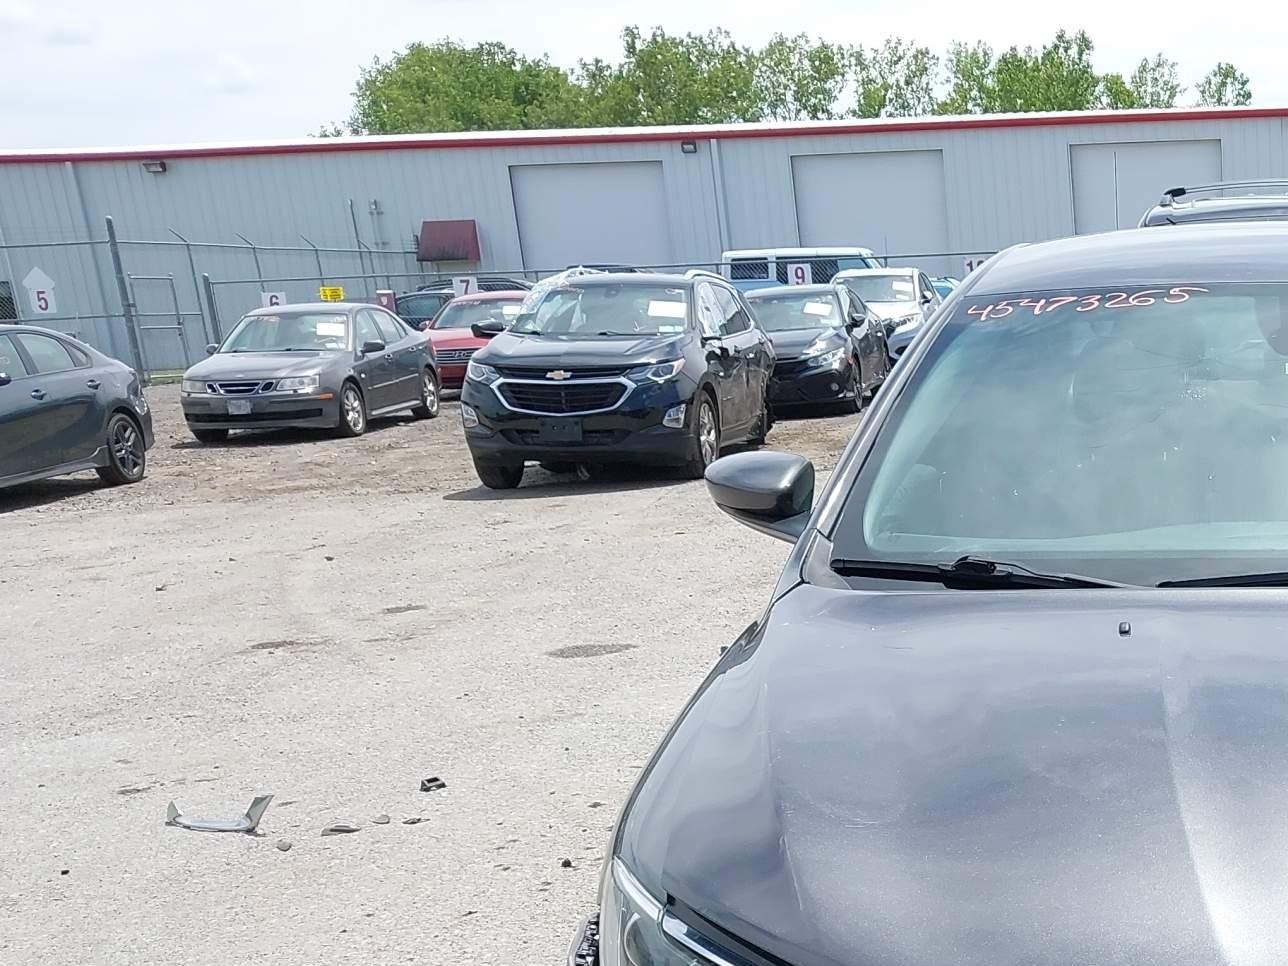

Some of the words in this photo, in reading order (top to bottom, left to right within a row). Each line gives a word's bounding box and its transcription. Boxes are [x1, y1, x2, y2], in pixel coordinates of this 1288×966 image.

[794, 266, 806, 285] 9
[460, 279, 470, 295] 7
[36, 290, 49, 311] 5
[967, 287, 1209, 321] 45473265
